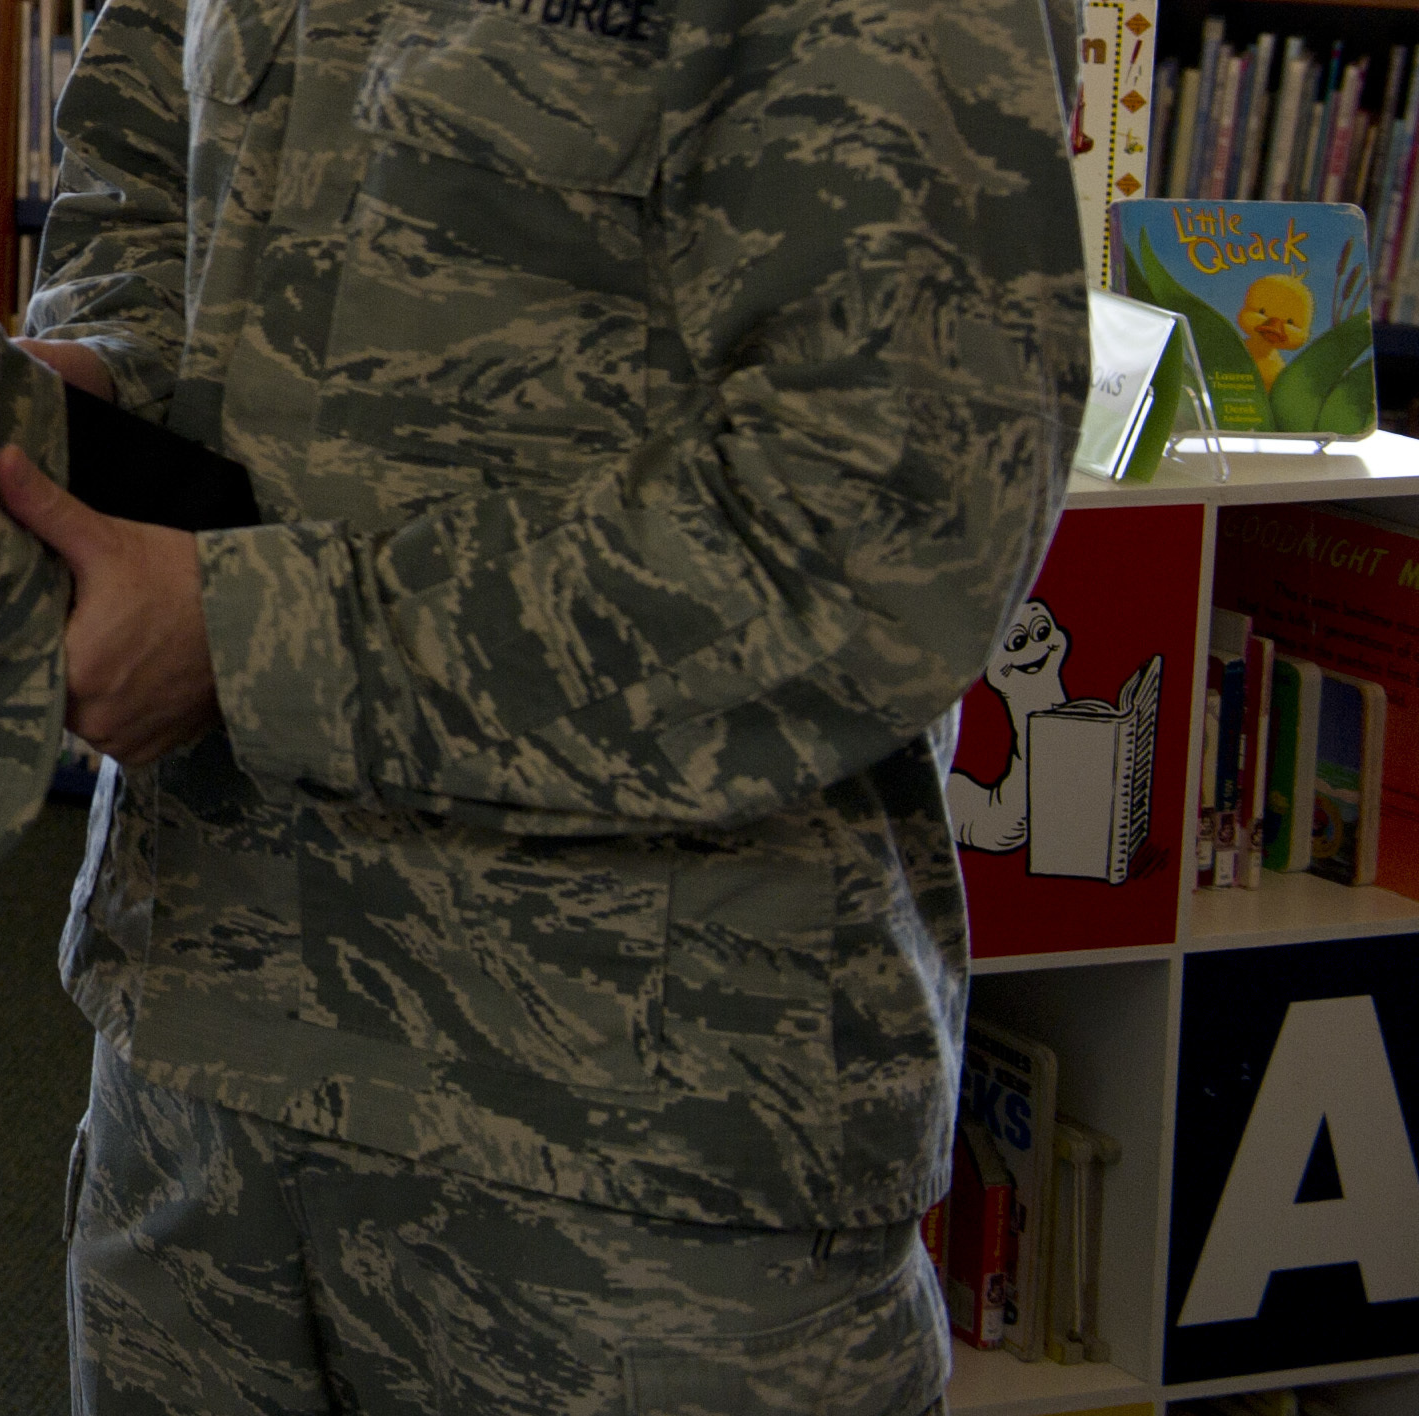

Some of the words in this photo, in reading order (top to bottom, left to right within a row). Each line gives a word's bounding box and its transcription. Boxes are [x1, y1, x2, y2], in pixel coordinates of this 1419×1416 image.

[1172, 206, 1243, 243] Little
[1187, 217, 1310, 274] Quack
[1215, 371, 1254, 382] Lauren
[1224, 515, 1391, 577] GOODNIGHT
[1176, 995, 1419, 1327] A
